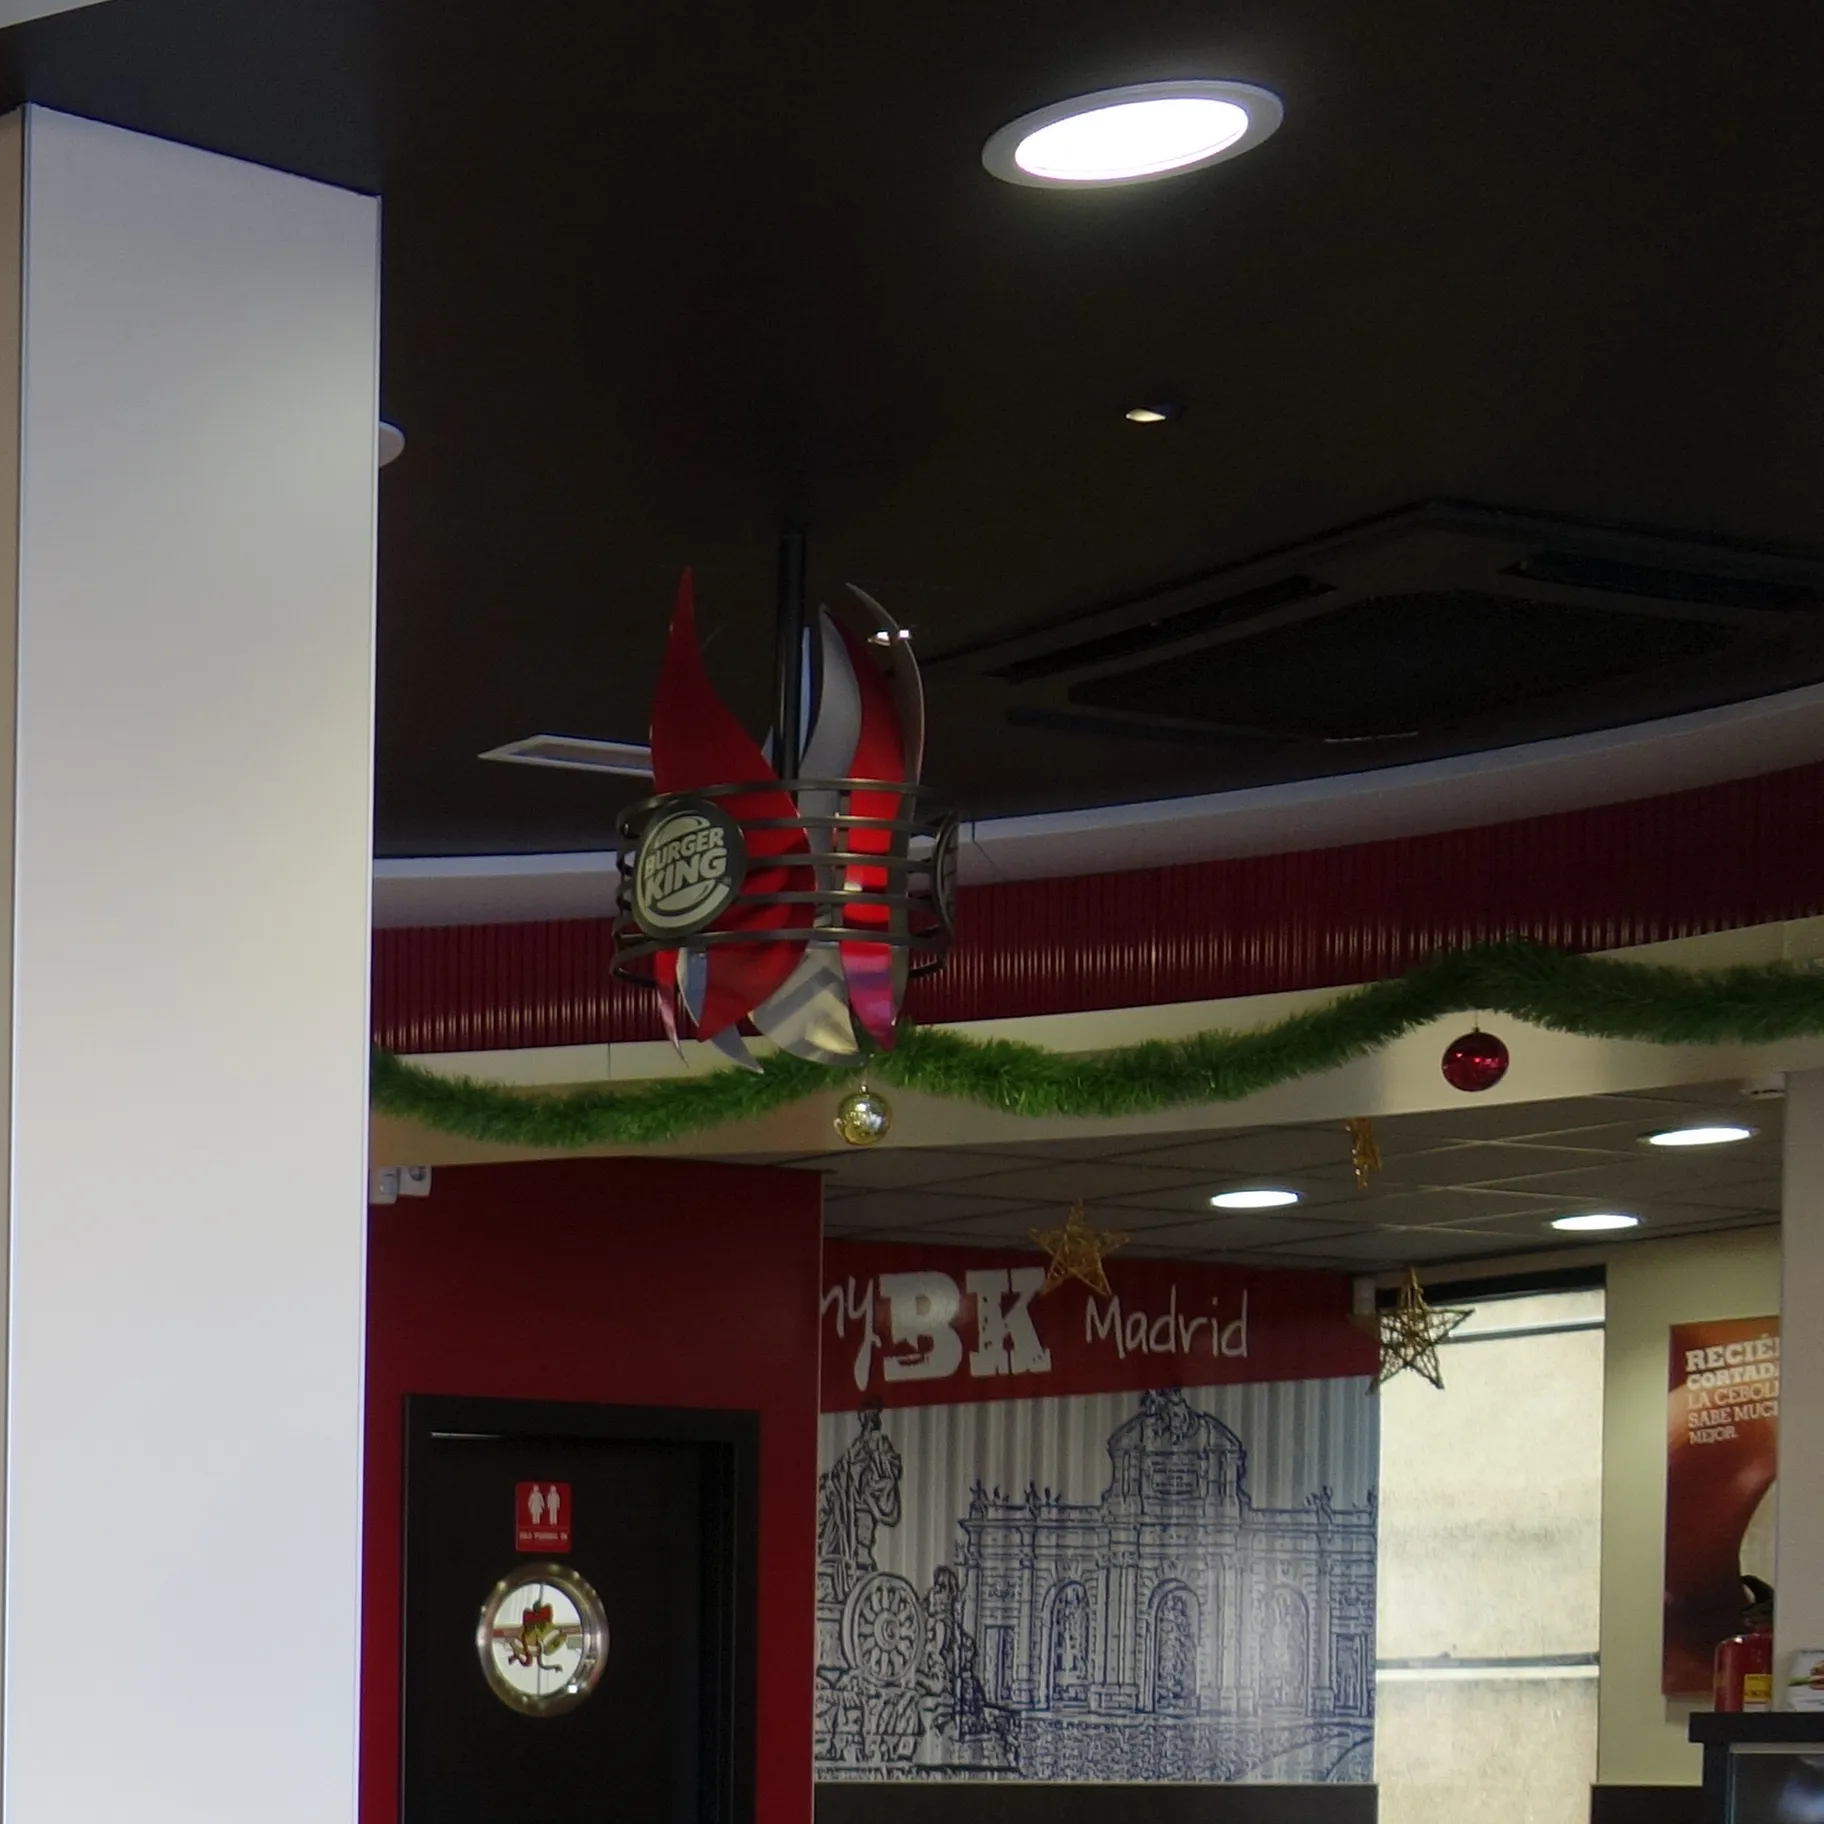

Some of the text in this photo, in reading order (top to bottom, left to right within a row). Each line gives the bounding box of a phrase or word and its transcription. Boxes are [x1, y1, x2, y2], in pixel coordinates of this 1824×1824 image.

[646, 848, 729, 902] KING
[647, 826, 725, 876] BURGER
[878, 1265, 1053, 1383] BK
[1084, 1285, 1250, 1359] Madrid
[1688, 1391, 1712, 1410] LA
[1688, 1407, 1732, 1429] SABE
